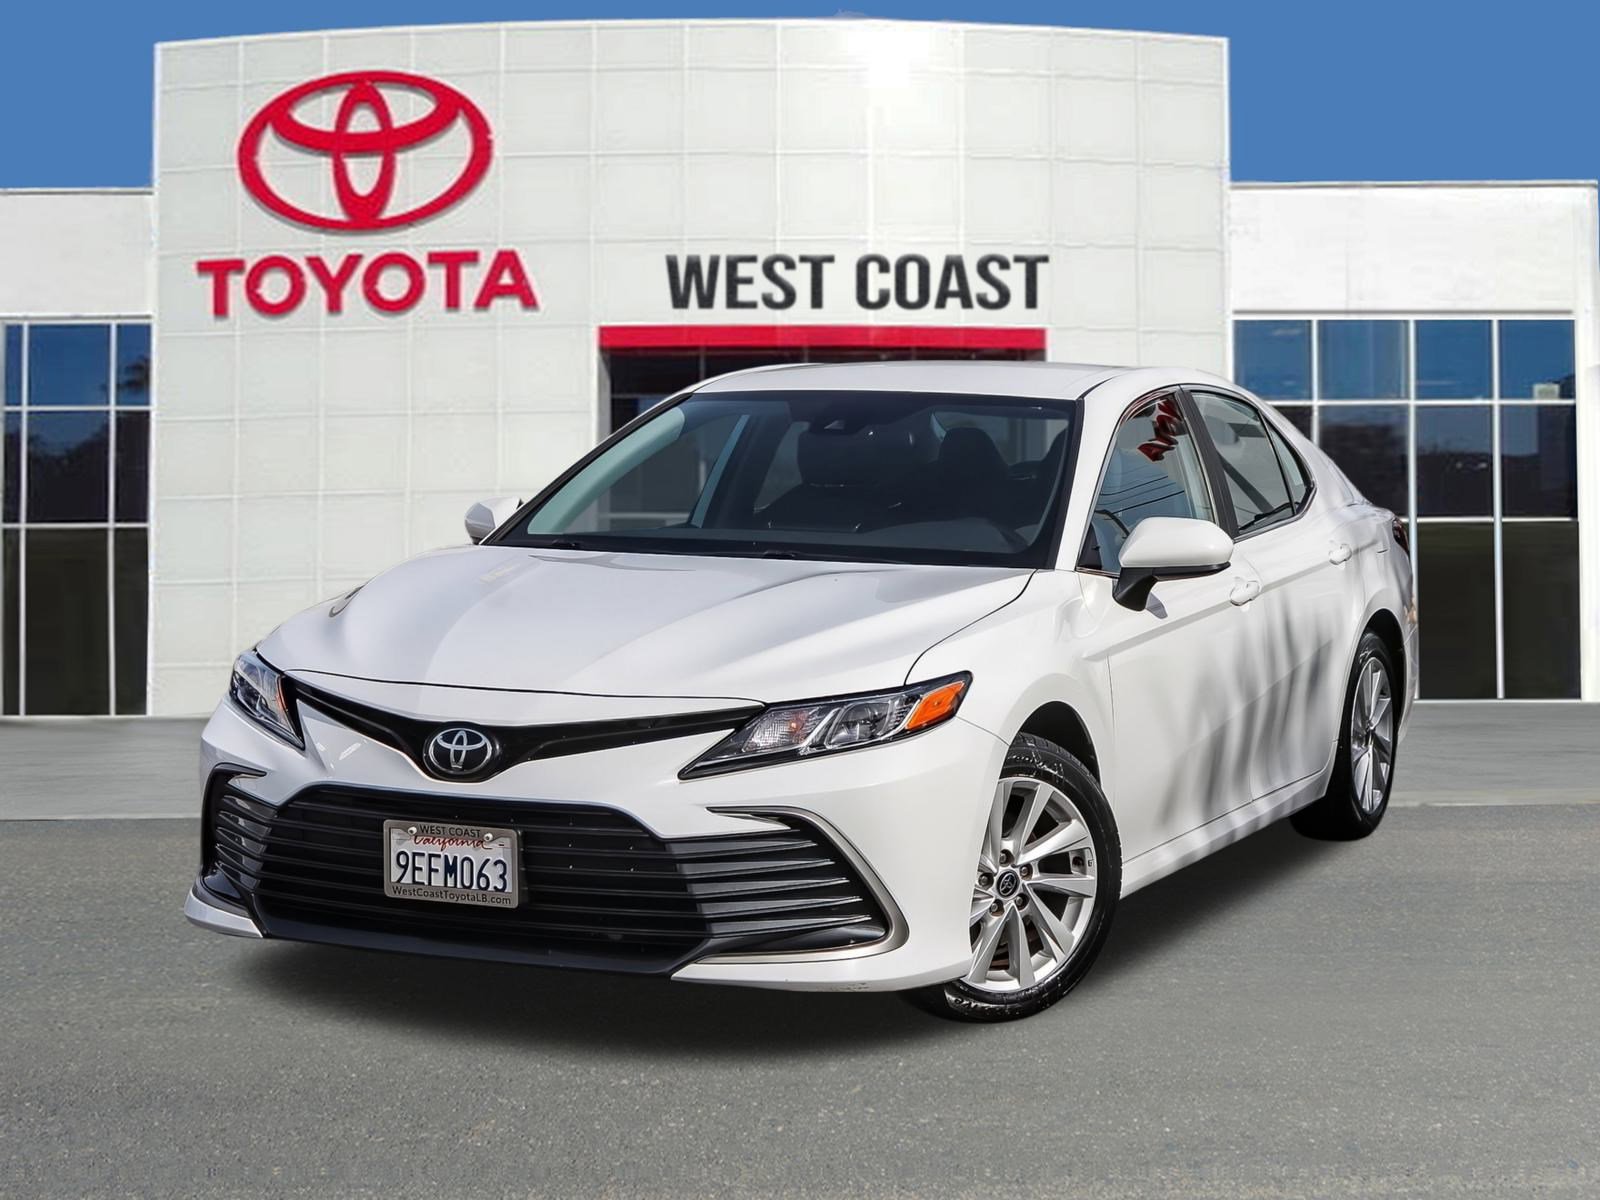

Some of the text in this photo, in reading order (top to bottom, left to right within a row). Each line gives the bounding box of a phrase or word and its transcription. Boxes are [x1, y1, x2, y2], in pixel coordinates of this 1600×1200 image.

[196, 250, 539, 317] TOYOTA
[666, 253, 1049, 310] WEST COAST
[420, 824, 481, 838] WEST COAST
[396, 851, 507, 893] 9EFM063
[392, 886, 511, 905] WestCoastToyotaLB.com
